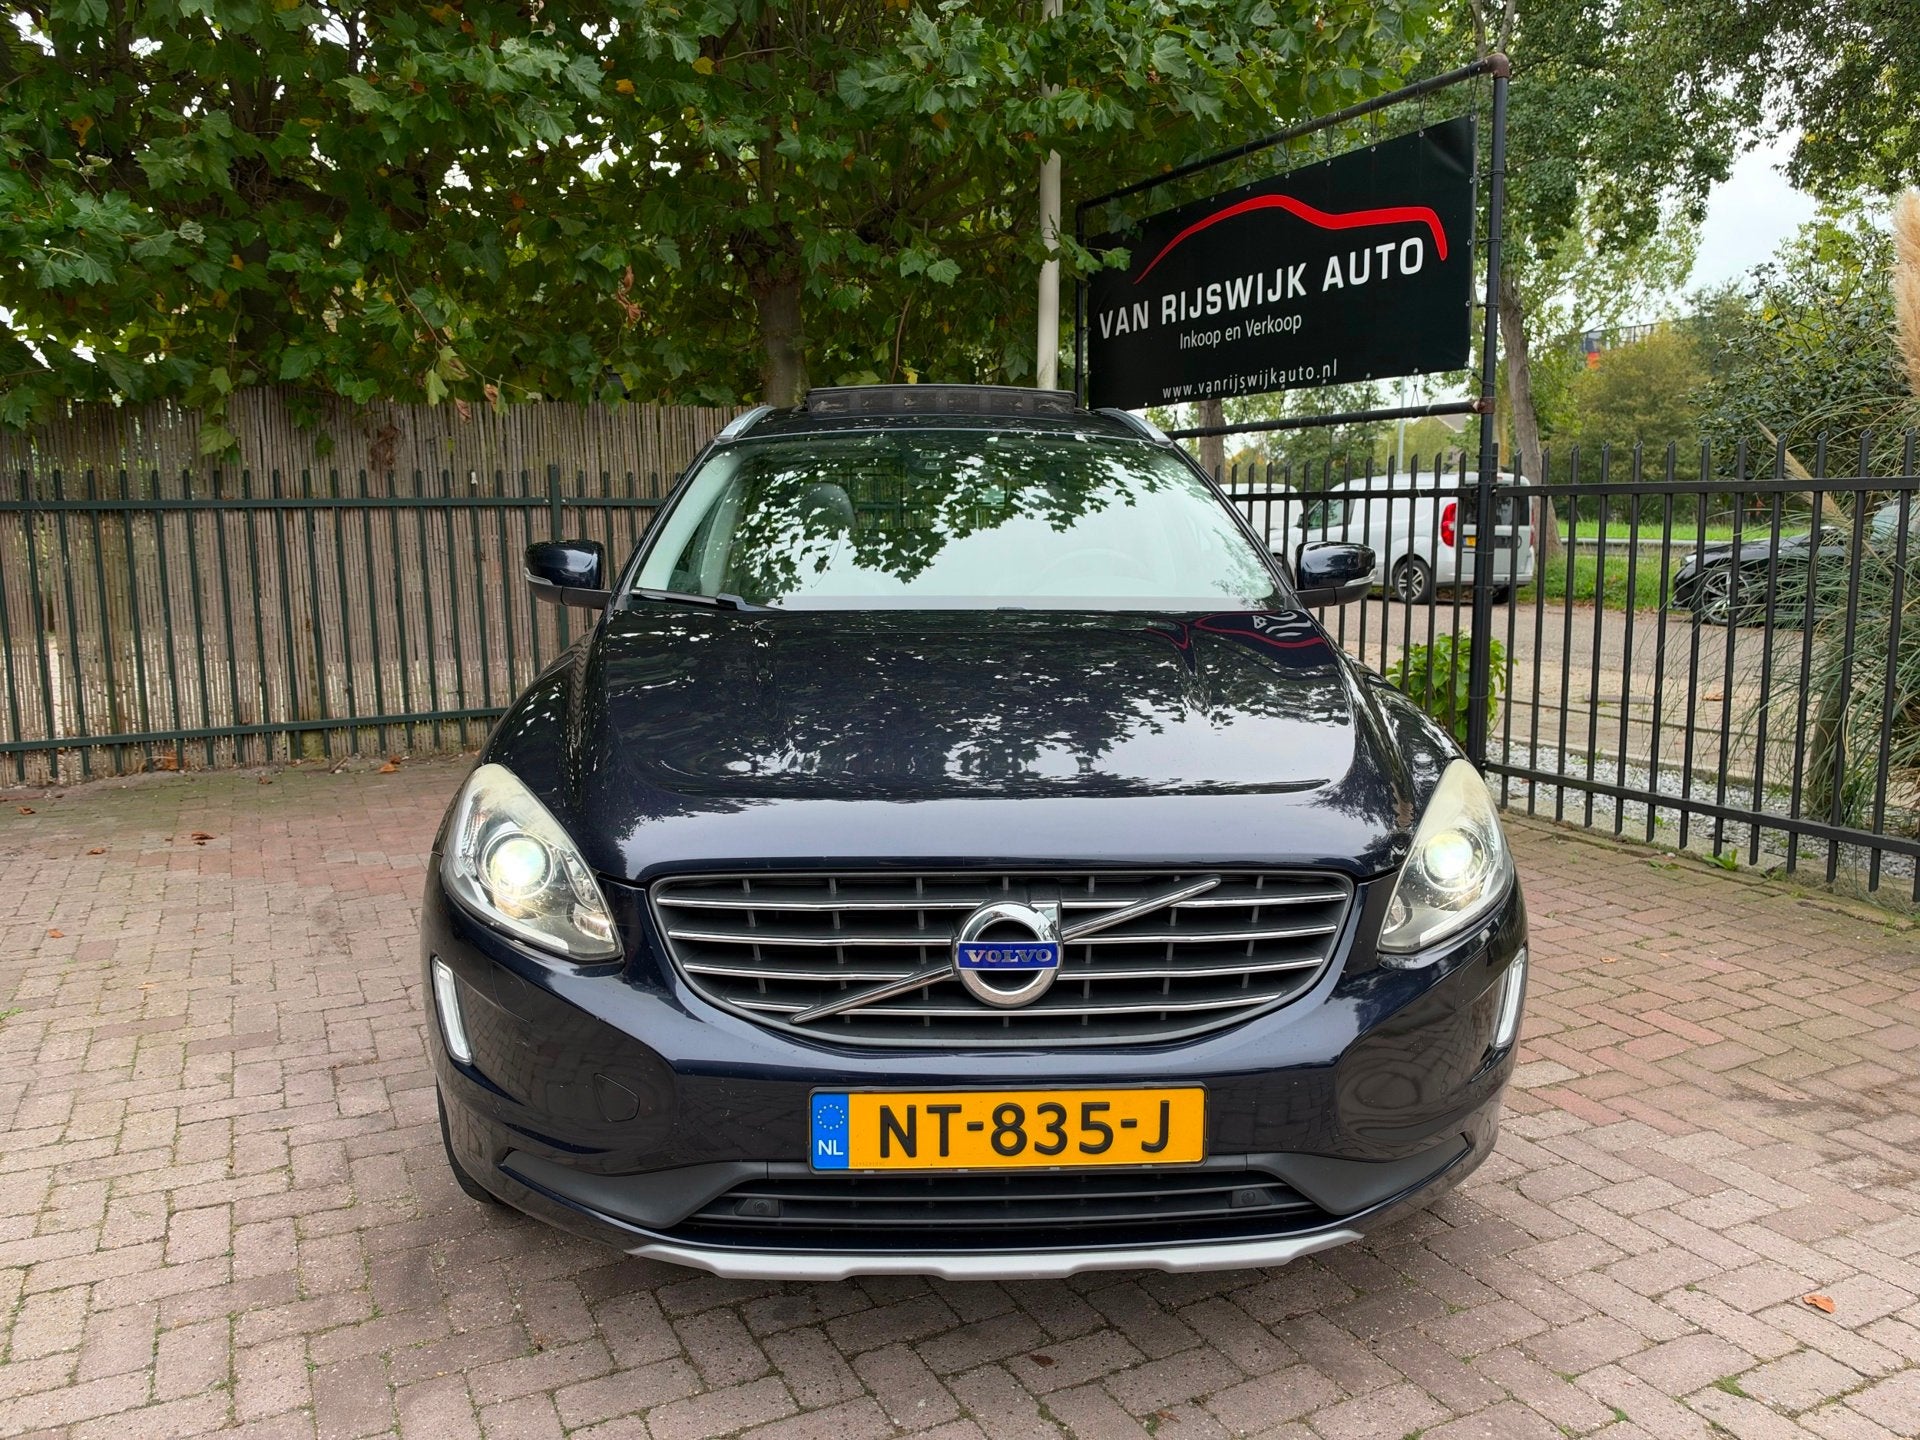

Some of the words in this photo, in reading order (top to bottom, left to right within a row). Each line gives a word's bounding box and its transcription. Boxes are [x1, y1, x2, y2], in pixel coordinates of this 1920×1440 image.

[1099, 301, 1149, 339] VAN
[1161, 262, 1307, 325] RIJSWIJK
[1322, 237, 1424, 292] AUTO
[1179, 331, 1221, 350] Inkoop
[1225, 328, 1241, 341] en
[1245, 313, 1302, 338] Verkoop
[1162, 359, 1338, 399] www.vanrijswijkauto.nl
[964, 948, 1053, 963] VOLVO
[817, 1139, 844, 1156] NL
[879, 1100, 1170, 1158] NT-835-J
